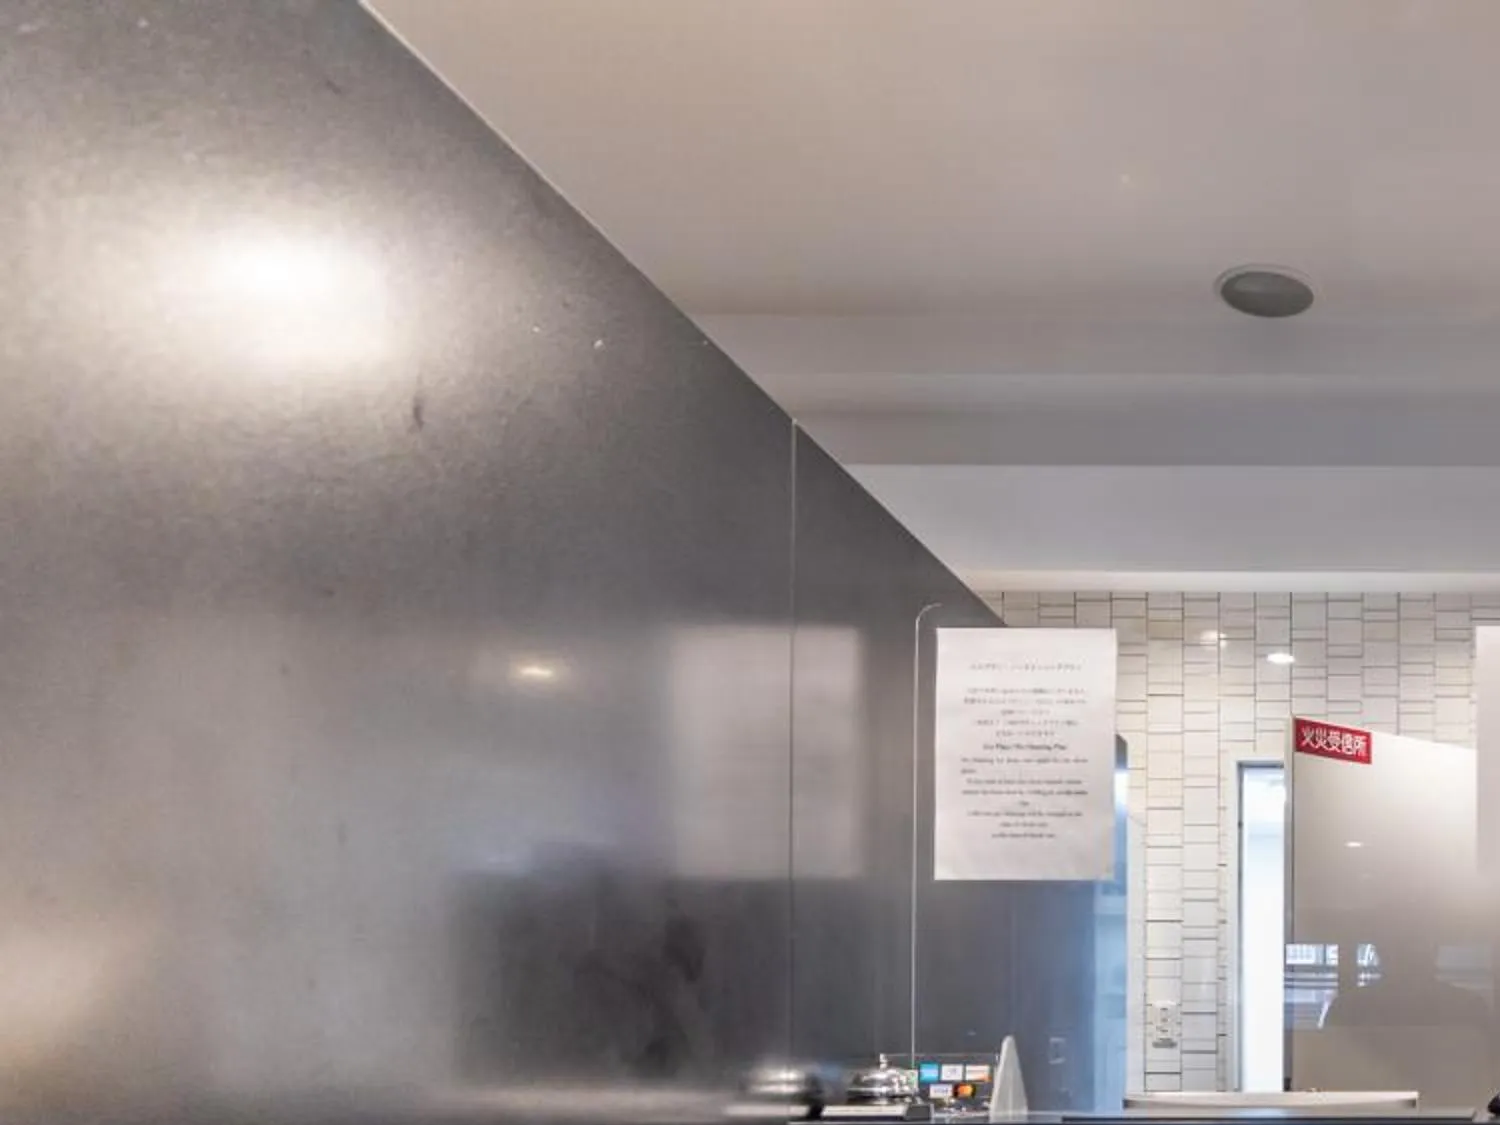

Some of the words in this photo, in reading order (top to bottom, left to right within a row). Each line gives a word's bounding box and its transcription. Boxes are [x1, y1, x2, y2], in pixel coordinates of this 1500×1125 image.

[1301, 725, 1367, 756] 火災受信所
